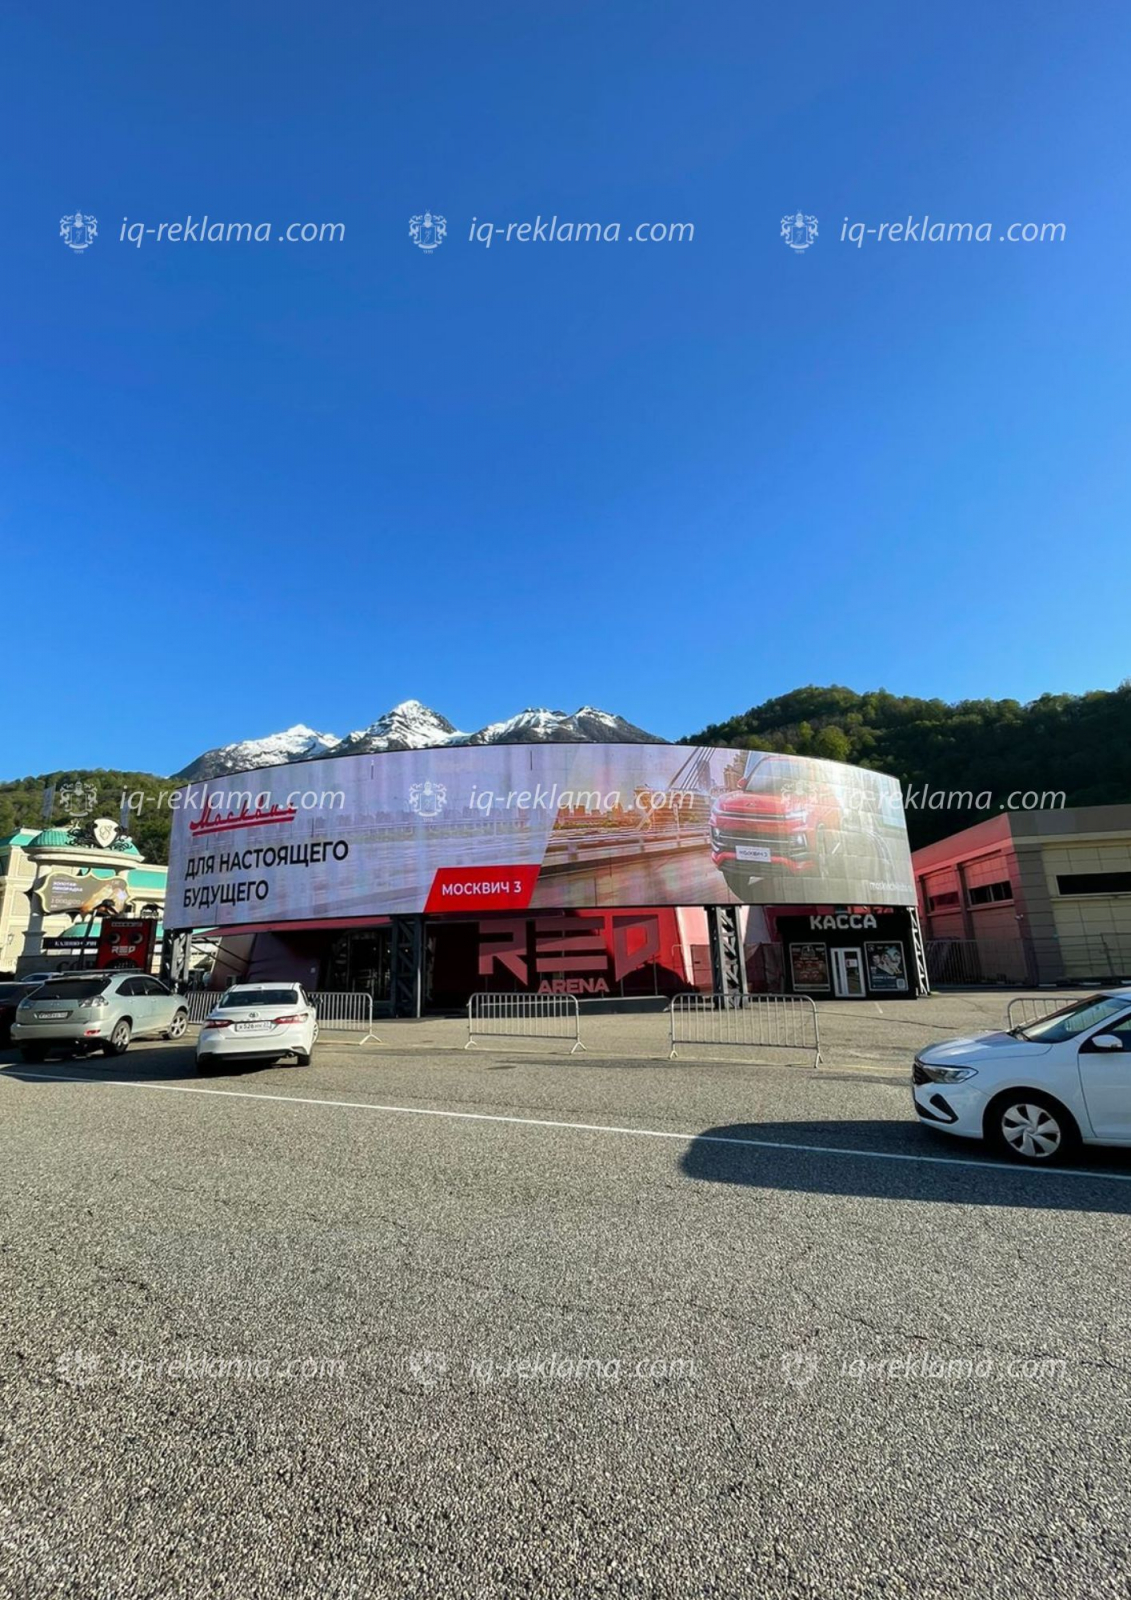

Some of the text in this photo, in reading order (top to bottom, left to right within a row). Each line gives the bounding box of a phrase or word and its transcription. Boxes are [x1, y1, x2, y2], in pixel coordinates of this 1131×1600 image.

[185, 840, 349, 881] ДЛЯ НАСТОЯЩЕГО
[183, 880, 269, 909] БУДУЩЕГО
[442, 880, 522, 896] МОСКВИЧ 3
[809, 913, 877, 930] КАССА
[538, 977, 610, 994] ARENA
